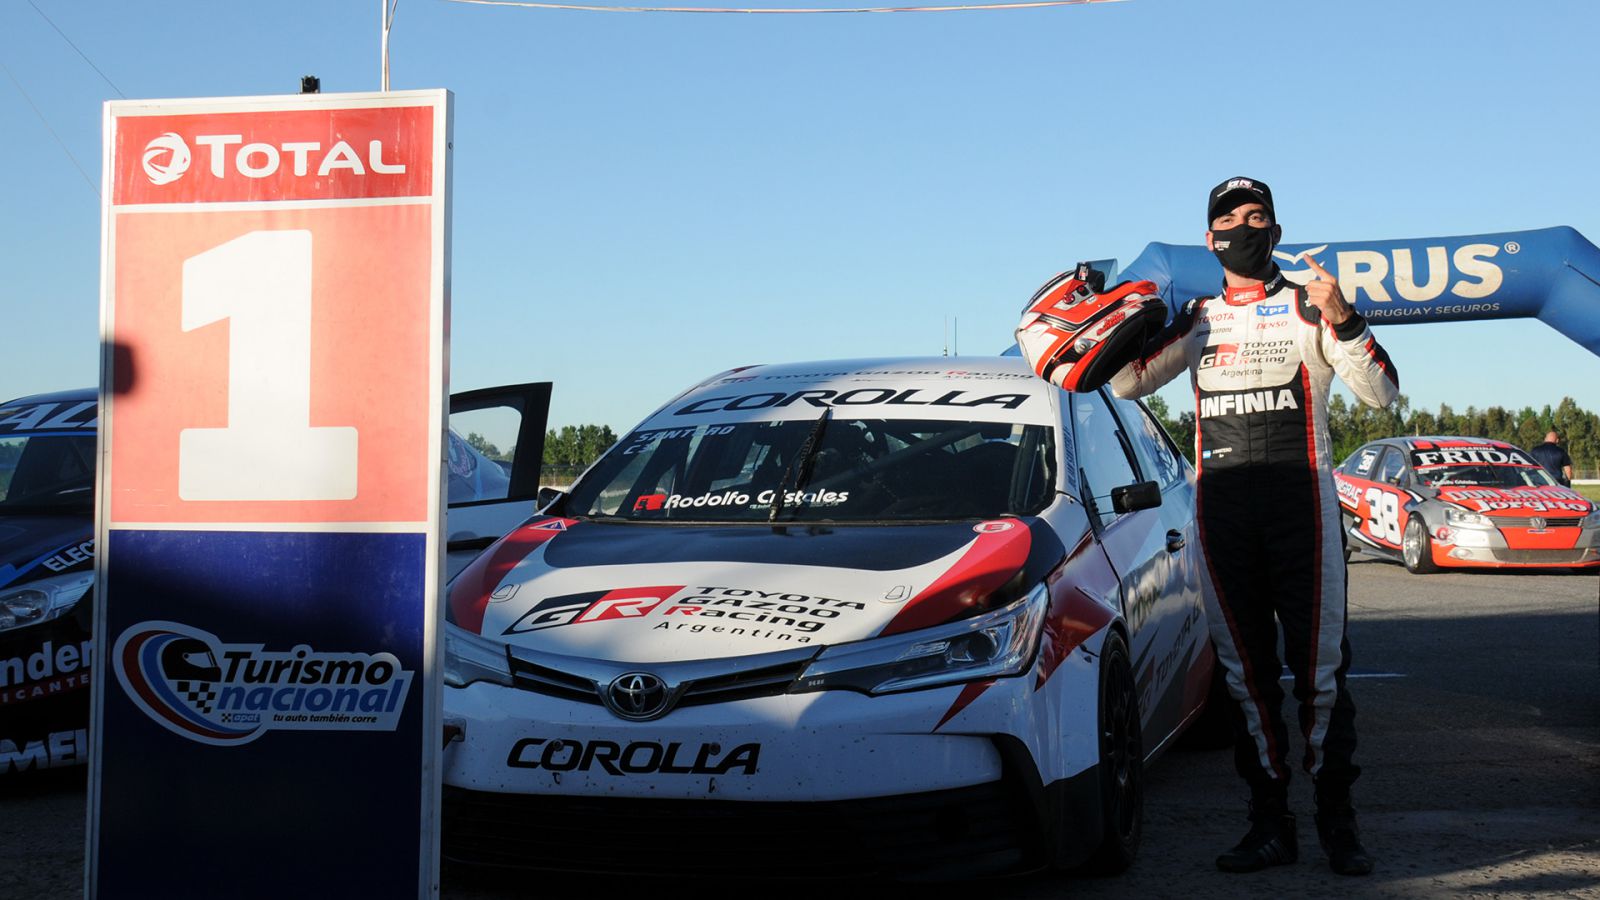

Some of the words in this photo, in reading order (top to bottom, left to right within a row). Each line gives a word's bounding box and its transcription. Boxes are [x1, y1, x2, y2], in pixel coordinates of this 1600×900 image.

[195, 134, 406, 179] TOTAL
[1336, 243, 1504, 304] RUS
[1199, 312, 1235, 325] TOYOTA
[1260, 306, 1287, 315] YPF
[1365, 306, 1432, 318] URUGUAY
[1435, 302, 1501, 314] SEGUROS
[1256, 320, 1288, 330] DENSO
[1241, 347, 1288, 357] GAZOO
[1243, 339, 1294, 349] TOYOTA
[178, 229, 359, 501] 1
[1238, 356, 1286, 365] Racing
[1220, 368, 1264, 378] Argentina
[673, 388, 1032, 416] COROLLA
[1200, 388, 1299, 419] INFINIA
[0, 401, 98, 430] AL
[1415, 450, 1533, 466] FRIDA
[663, 490, 750, 510] Rodolfo
[757, 488, 850, 505] Crstales
[1475, 499, 1588, 513] Jorgito
[1365, 487, 1402, 546] 38
[42, 538, 95, 572] ELEC
[677, 596, 842, 620] GAZOO
[696, 586, 866, 610] TOYOTA
[512, 596, 664, 632] GR
[663, 604, 827, 634] Racing
[652, 621, 812, 643] Argentina
[222, 649, 394, 686] Turismo
[218, 678, 405, 713] nacional
[272, 714, 284, 722] tu
[285, 714, 308, 722] auto
[309, 713, 350, 723] también
[352, 715, 378, 723] corre
[506, 737, 762, 776] COROLLA
